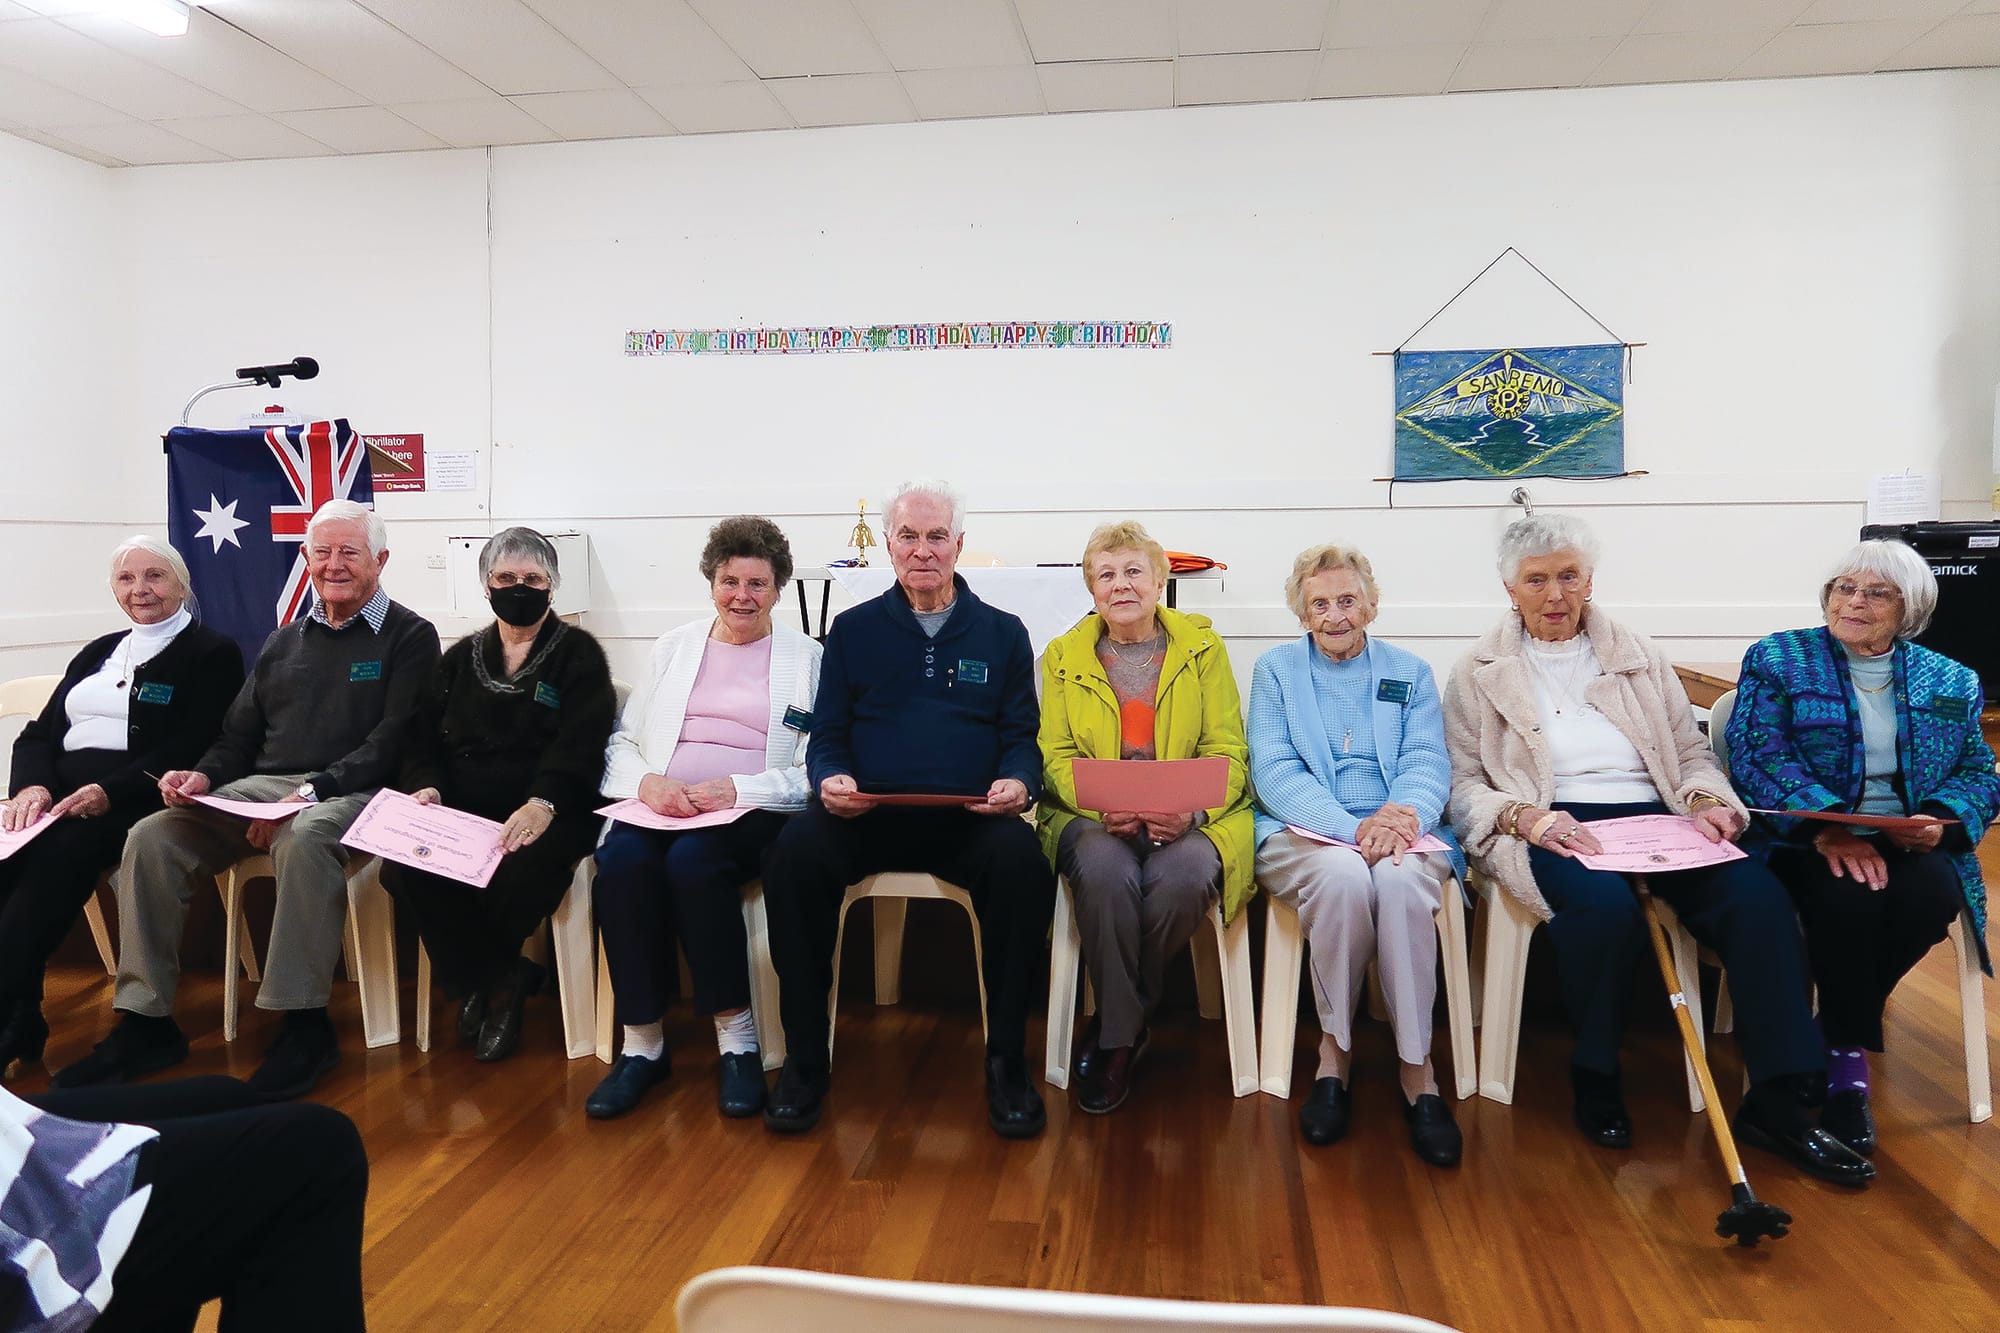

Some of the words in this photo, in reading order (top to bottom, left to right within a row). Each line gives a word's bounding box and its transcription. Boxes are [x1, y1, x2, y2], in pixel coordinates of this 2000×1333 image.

[632, 332, 685, 349] HAPPY
[719, 332, 799, 349] BIRTHDAY
[808, 330, 862, 348] HAPPY
[897, 327, 980, 346] BIRTHDAY
[990, 326, 1046, 345] HAPPY
[1083, 324, 1169, 344] BIRTHDAY
[1470, 371, 1505, 394] SAN
[1509, 369, 1565, 396] REMO
[1501, 390, 1515, 408] P
[365, 436, 406, 447] fibrillator
